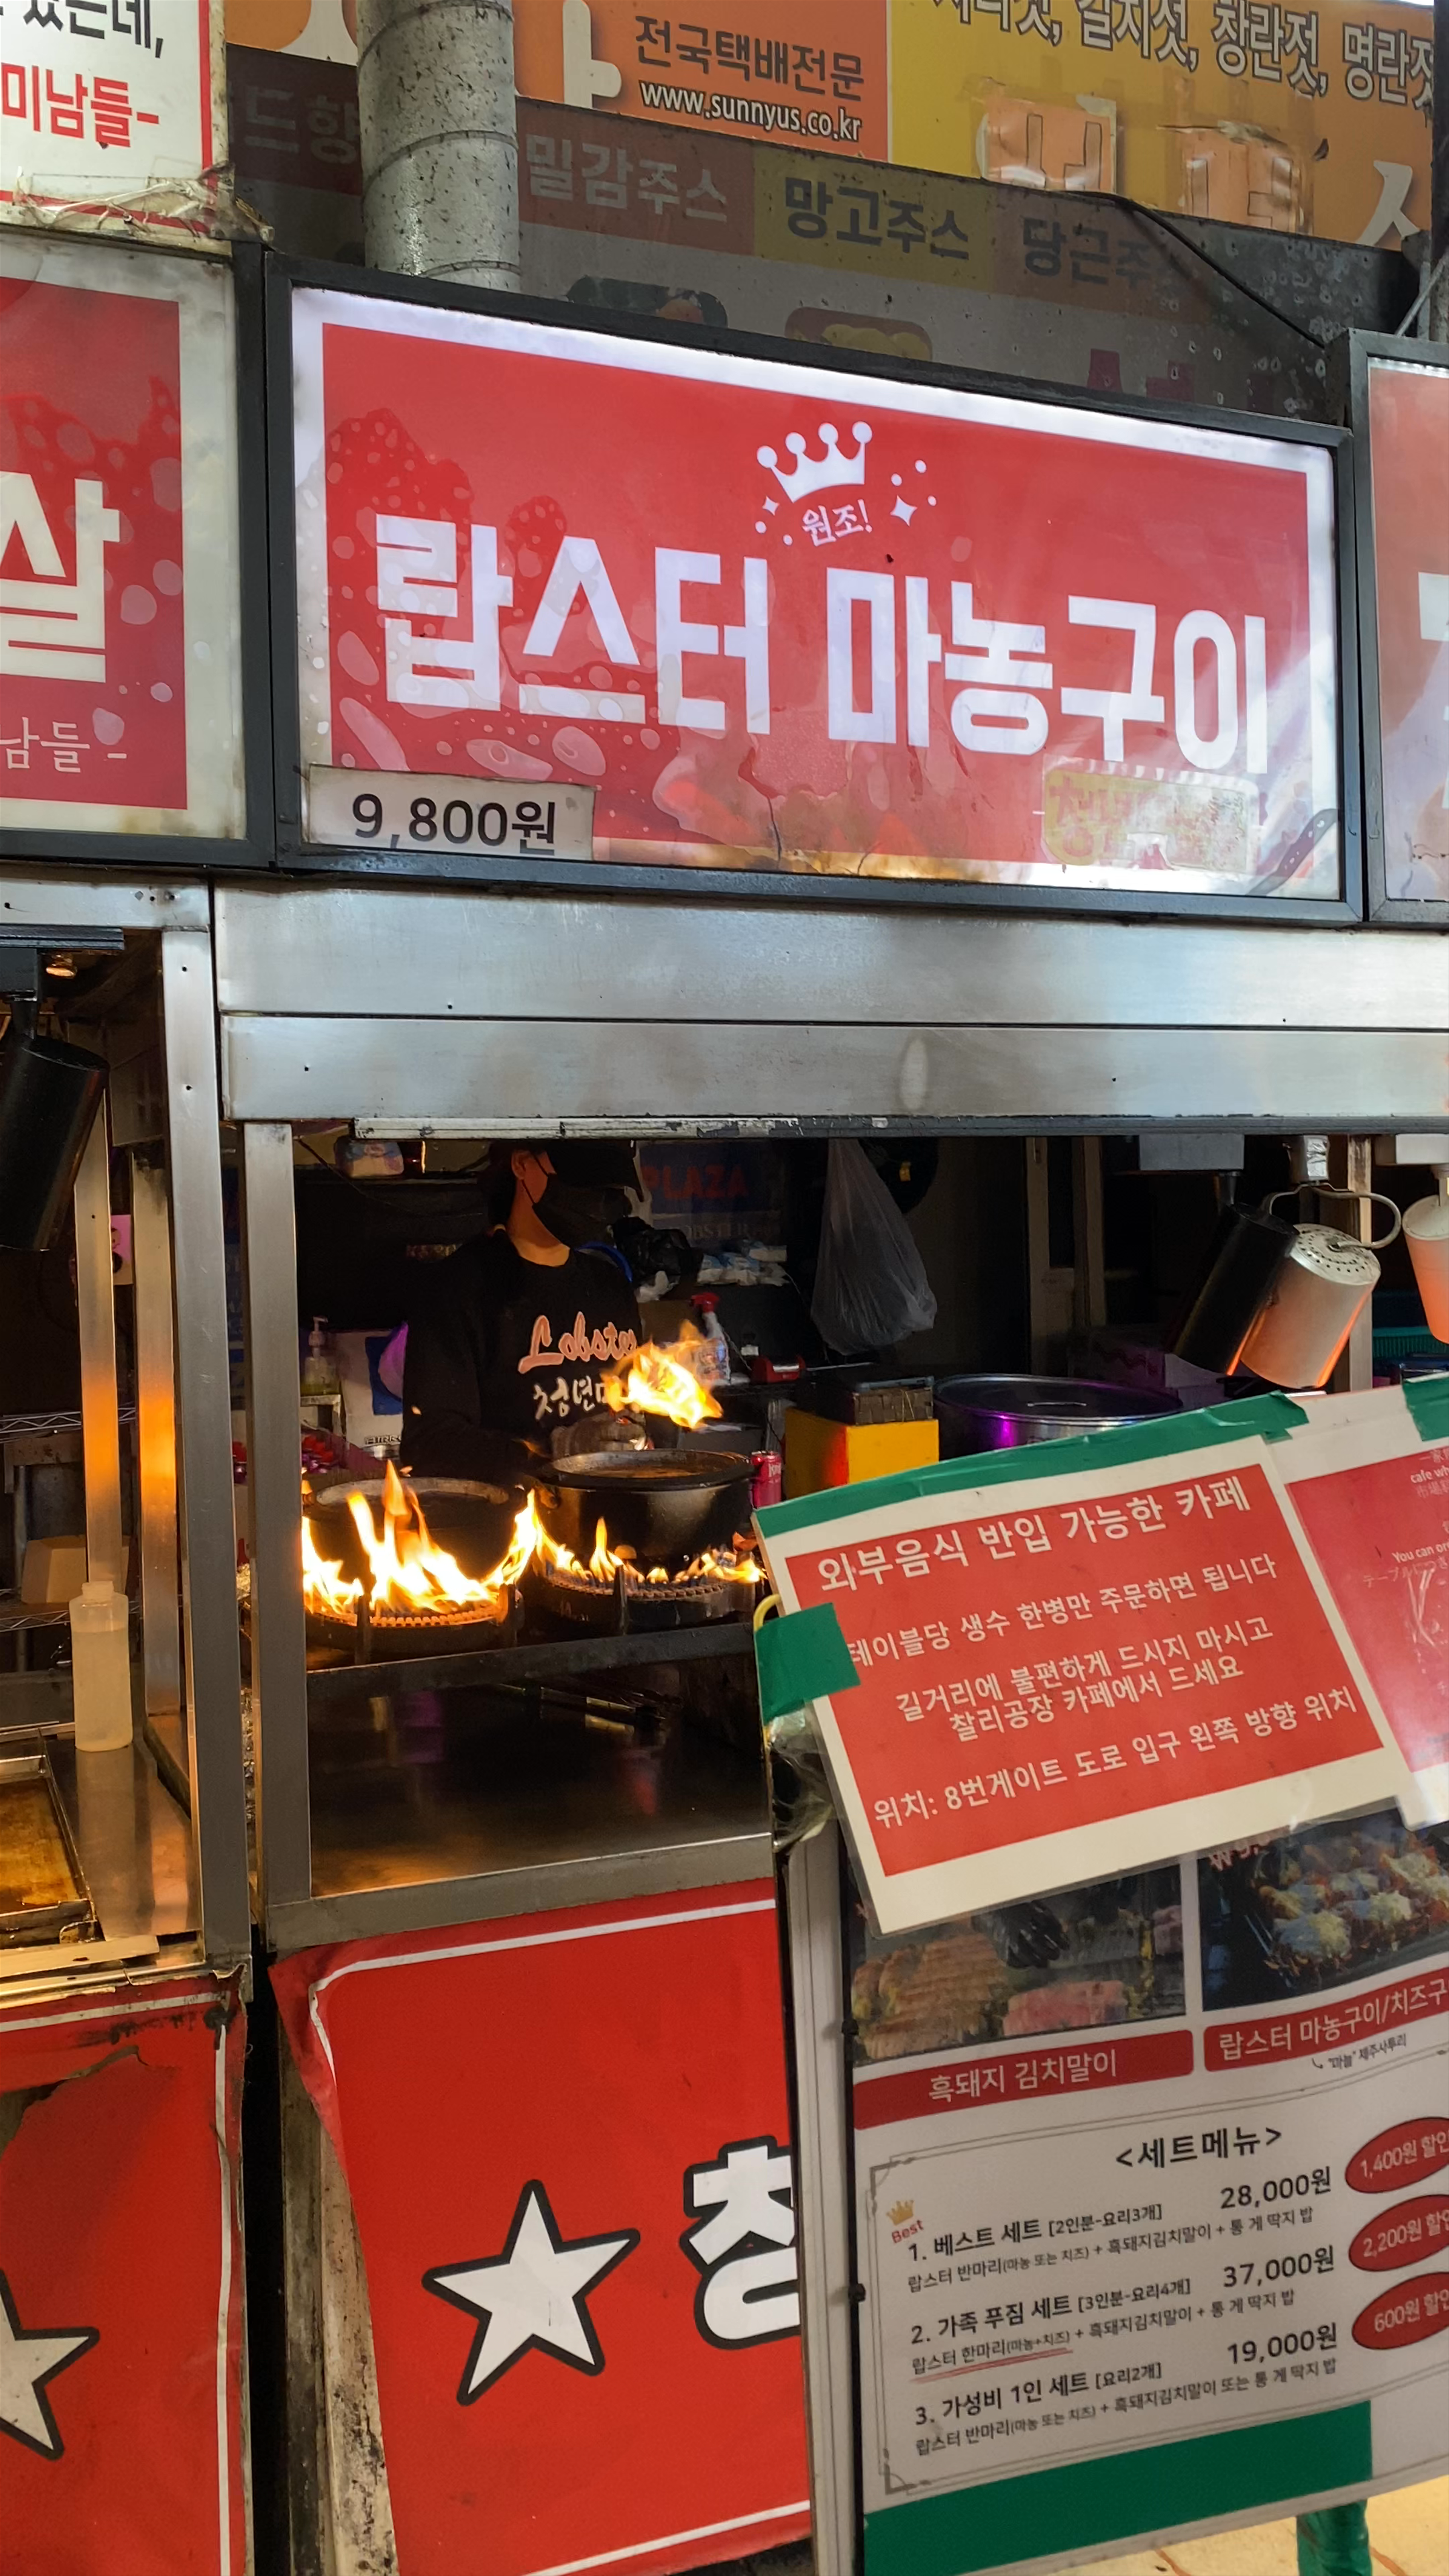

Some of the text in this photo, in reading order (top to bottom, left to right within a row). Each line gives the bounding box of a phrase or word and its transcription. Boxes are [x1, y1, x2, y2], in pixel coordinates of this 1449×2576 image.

[635, 15, 864, 102] 전국택배전문
[639, 80, 862, 142] www.sunnyus.co.kr
[525, 134, 728, 224] 밀감주스
[785, 176, 969, 260] 망고주스
[802, 499, 873, 546] 원조!
[377, 513, 1267, 774] 랍스터 마농구이
[352, 793, 556, 855] 9,800원
[1411, 1470, 1433, 1484] cafe
[817, 1475, 1251, 1592] 외부음식 반입 가능한 카페
[1392, 1551, 1414, 1563] You
[1415, 1546, 1434, 1558] can
[846, 1553, 1278, 1668] 테이블당 생수 한병만 주문하면 됩니다
[895, 1616, 1274, 1723] 길거리에 불편하게 드시지 마시고
[950, 1655, 1244, 1743] 찰리공장 카페에서 드세요
[873, 1686, 1359, 1830] 위치: 8번게이트 도로 입구 왼쪽 방향 위치
[1219, 2022, 1292, 2061] 랍스터
[929, 2049, 1117, 2103] 흑돼지 김치말이
[1360, 2140, 1417, 2179] 1,400원
[1220, 2166, 1332, 2210] 28,000원
[891, 2219, 924, 2244] Best
[908, 2243, 927, 2261] 1.
[934, 2227, 995, 2256] 베스트
[1001, 2219, 1042, 2244] 세트
[908, 2267, 952, 2293] 랍스터
[1034, 2253, 1058, 2267] 또는
[1300, 2206, 1313, 2224] 밥
[1363, 2218, 1422, 2258] 2,200원
[1223, 2245, 1335, 2287] 37,000원
[911, 2325, 931, 2344] 2.
[938, 2311, 978, 2338] 가족
[984, 2302, 1024, 2330] 푸짐
[1031, 2295, 1072, 2319] 세트
[912, 2349, 956, 2375] 랍스터
[1281, 2288, 1295, 2305] 밥
[1374, 2297, 1420, 2333] 600원
[1227, 2322, 1338, 2365] 19,000원
[915, 2406, 935, 2425] 3.
[942, 2388, 1002, 2418] 가성비
[1010, 2379, 1042, 2404] 1인
[1048, 2372, 1089, 2396] 세트
[915, 2430, 961, 2456] 랍스터
[1042, 2413, 1065, 2427] 또는
[1221, 2376, 1250, 2393] 또는
[1323, 2357, 1337, 2375] 밥
